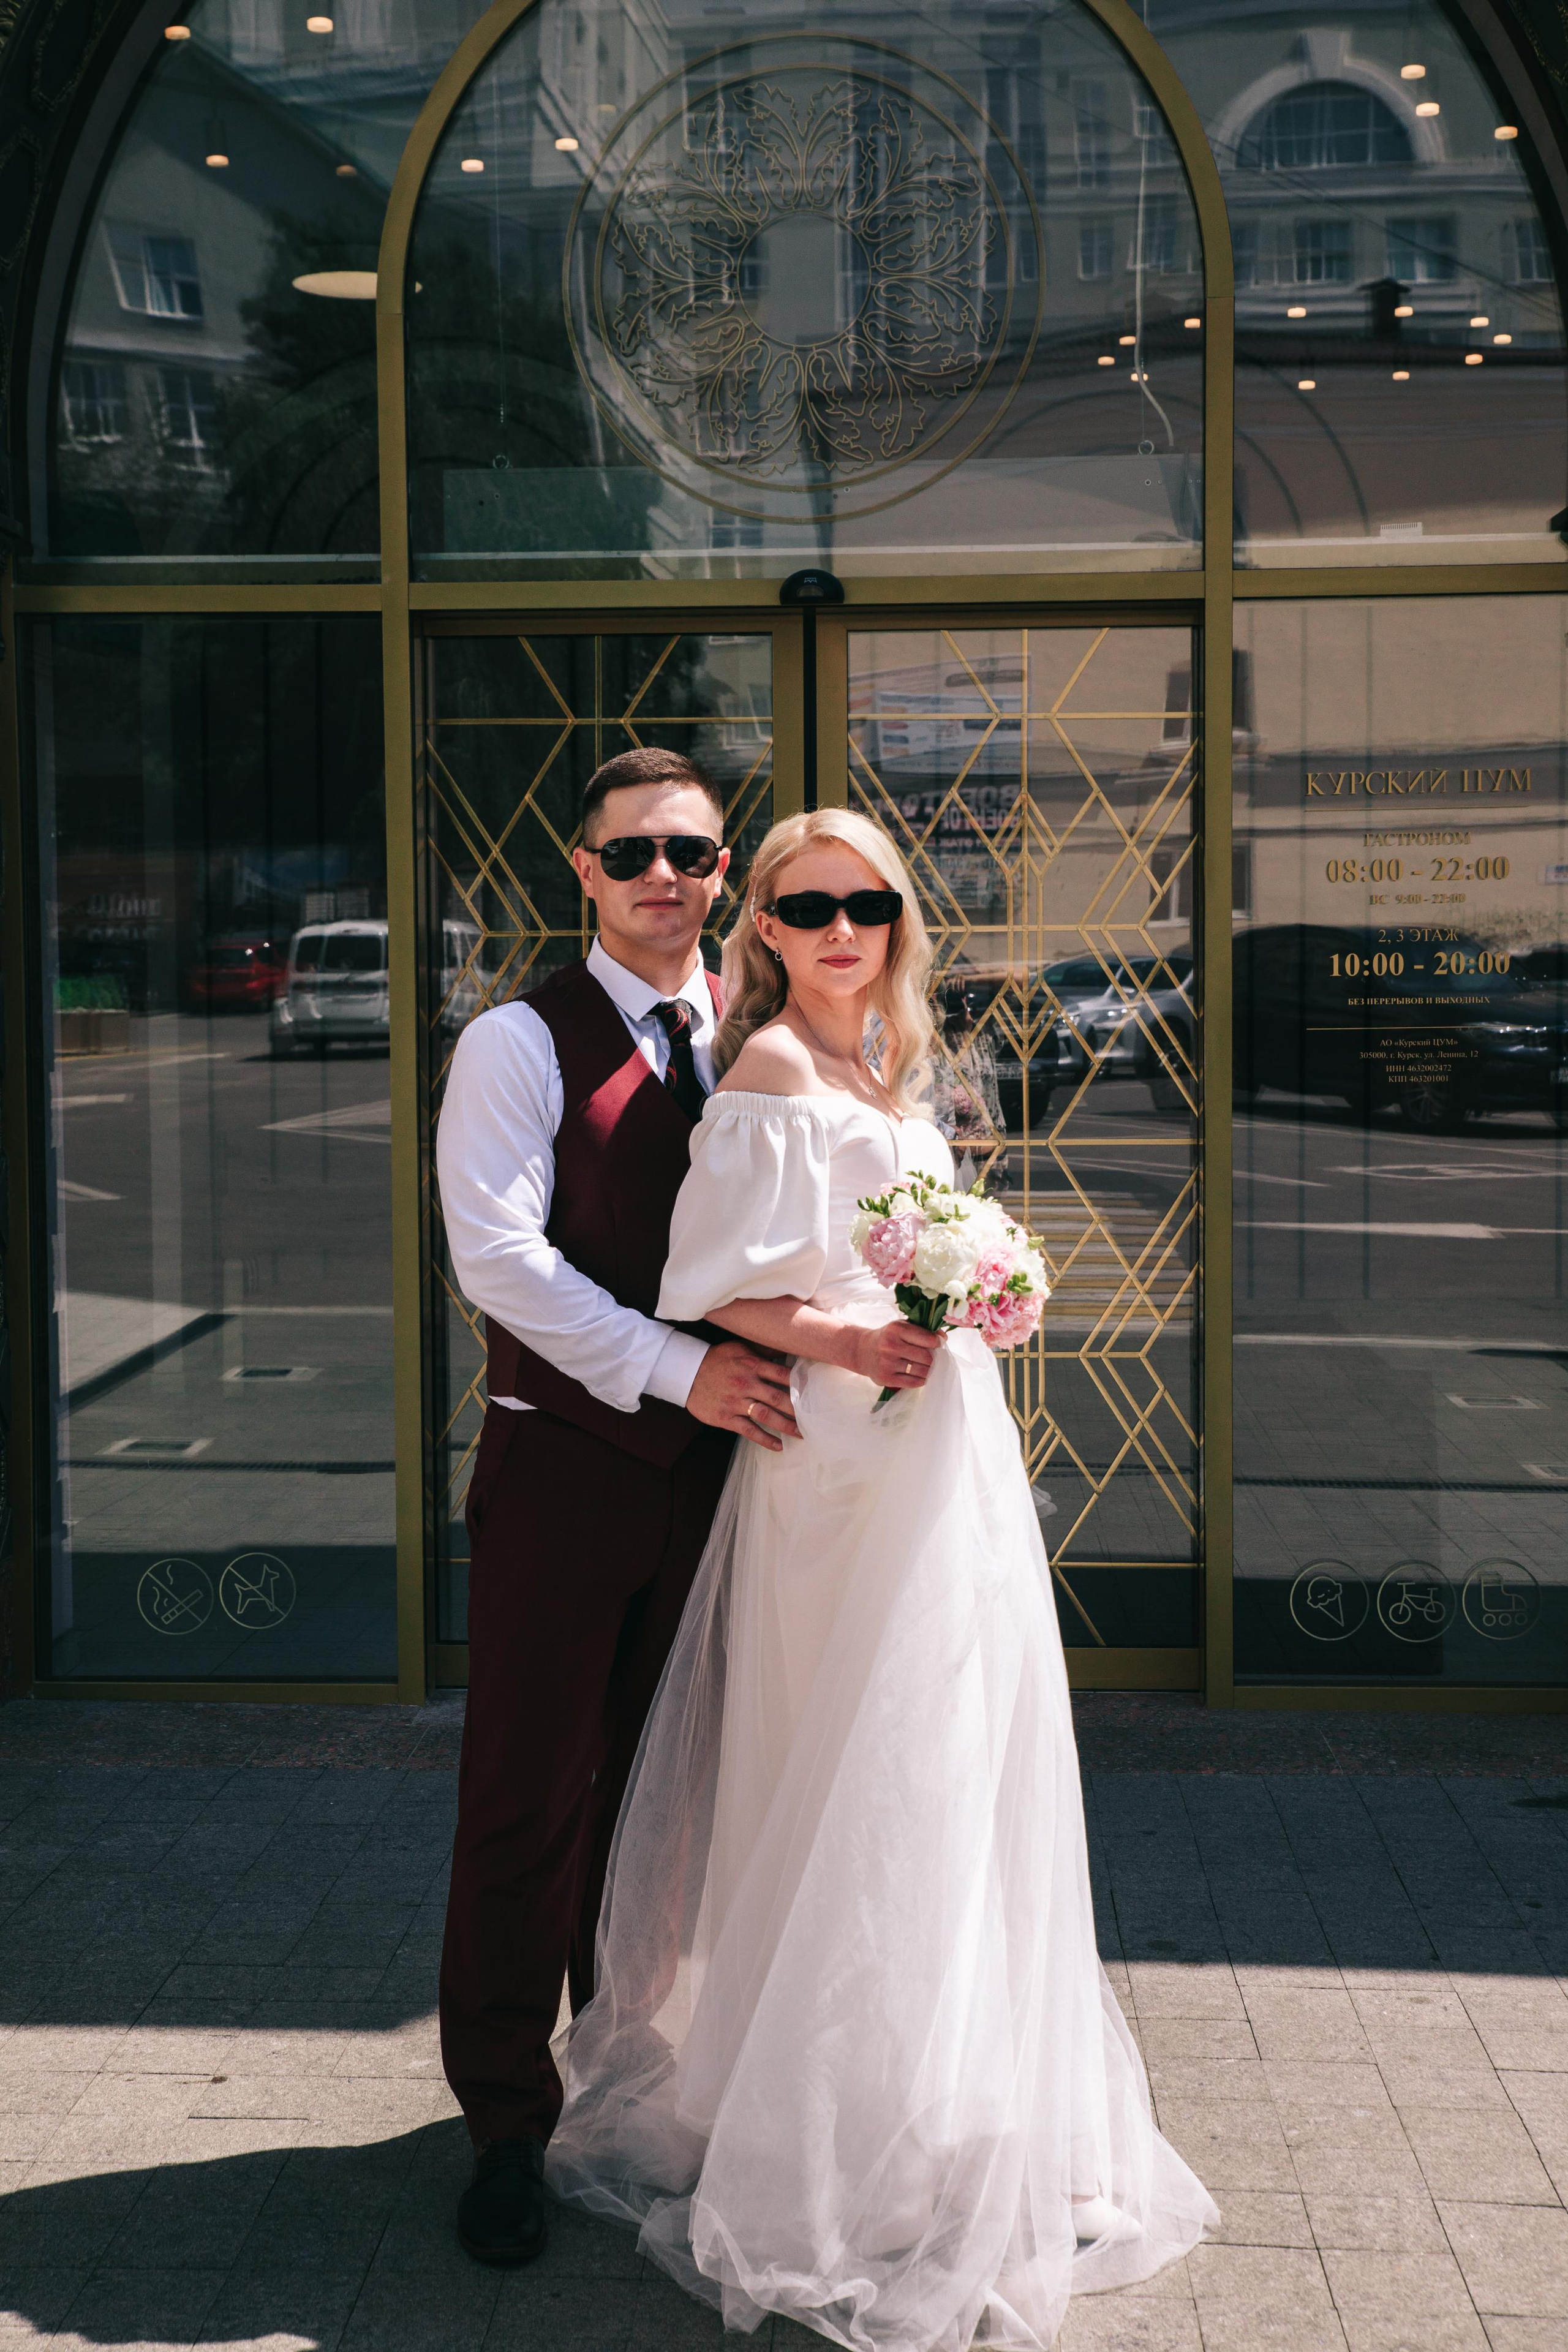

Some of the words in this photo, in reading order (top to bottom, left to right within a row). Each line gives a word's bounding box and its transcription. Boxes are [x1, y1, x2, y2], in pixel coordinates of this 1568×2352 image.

[1306, 767, 1449, 796] КУРСКИЙ
[1462, 767, 1531, 793] ЦУМ
[1363, 831, 1472, 847] ГАСТРОНОМ
[1327, 858, 1404, 883] 08:00
[1430, 856, 1510, 881] 22:00
[1378, 929, 1391, 944] 2,
[1396, 929, 1404, 942] 3
[1409, 928, 1460, 942] ЭТАЖ
[1329, 952, 1404, 977] 10:00
[1433, 951, 1510, 975] 20:00
[1366, 997, 1424, 1005] ПЕРЕРЫВОВ
[1435, 995, 1491, 1005] ВЫХОДНЫХ
[1394, 1038, 1431, 1048] «Курский
[1409, 1074, 1449, 1083] 463201001
